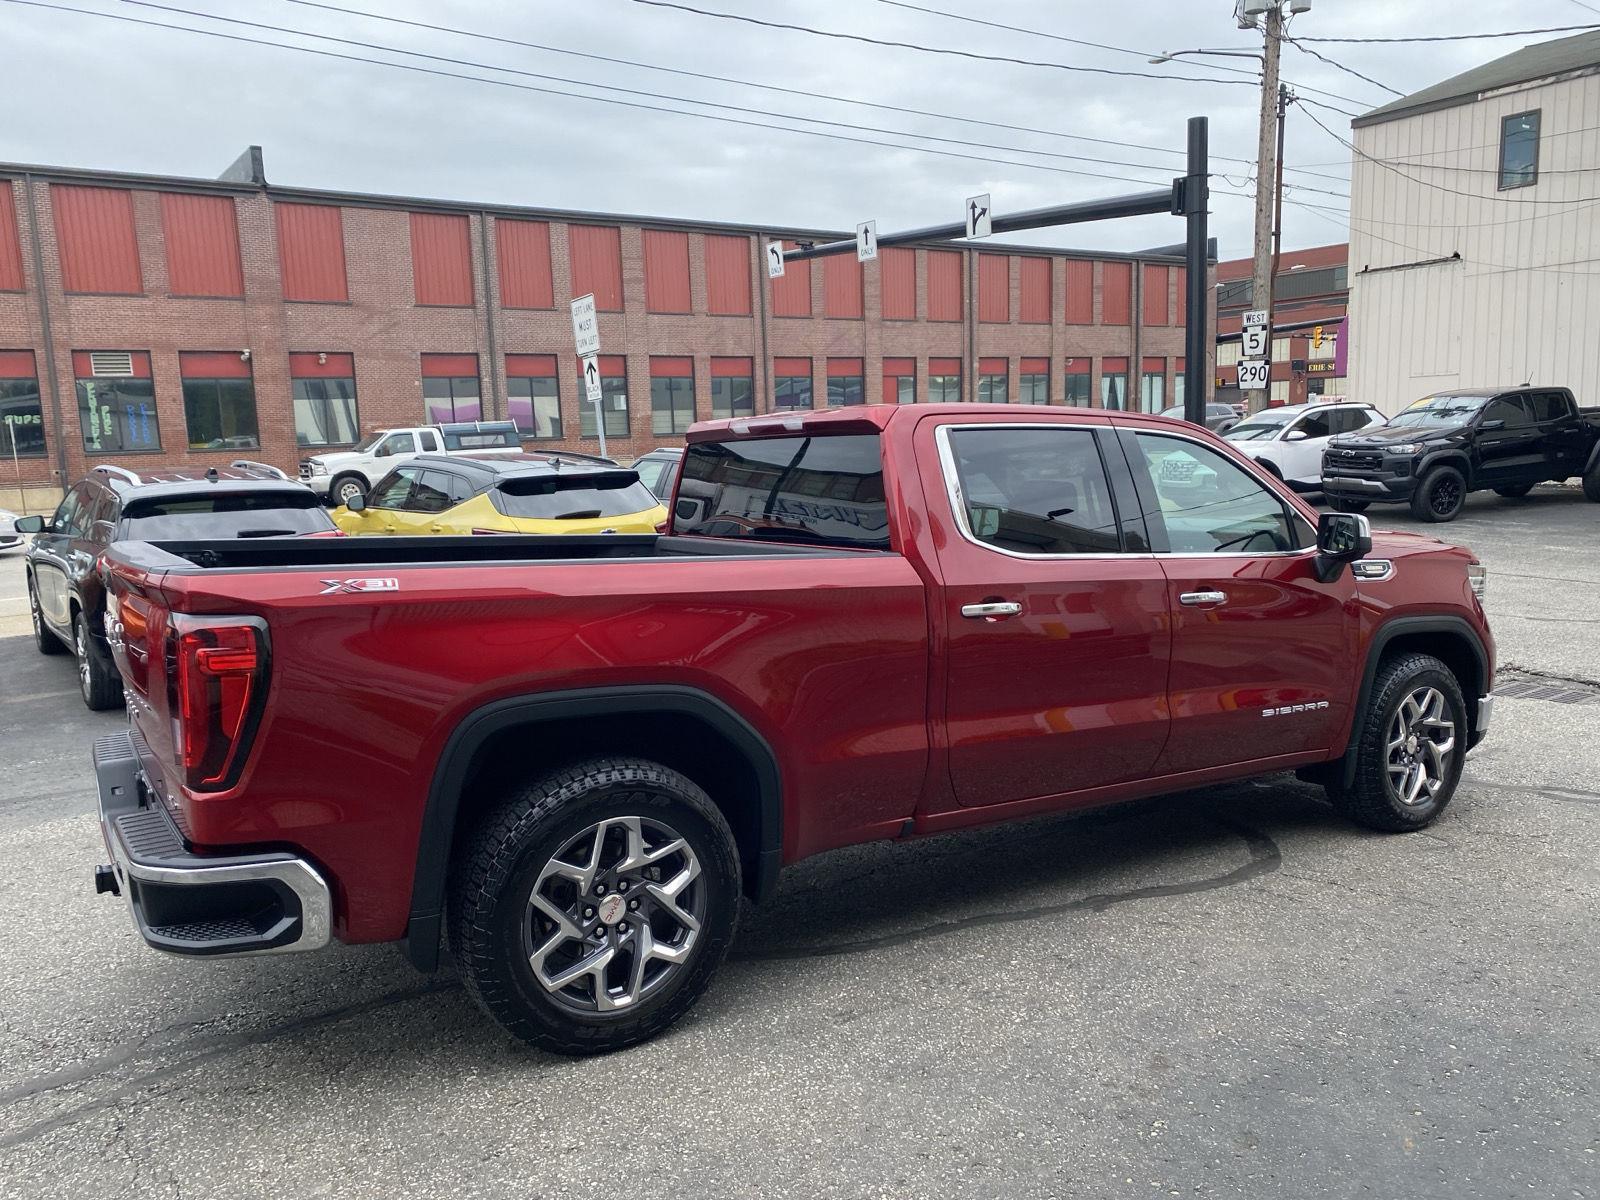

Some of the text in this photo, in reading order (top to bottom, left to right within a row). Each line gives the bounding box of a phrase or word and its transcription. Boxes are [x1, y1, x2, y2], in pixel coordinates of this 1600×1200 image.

[861, 247, 874, 256] ONLY
[770, 266, 782, 275] ONLY
[574, 302, 594, 316] LEFT LANE
[1246, 313, 1265, 324] WEST
[579, 319, 592, 332] MUST
[578, 335, 597, 348] TURN LEFT
[1249, 333, 1260, 350] 5
[1240, 365, 1267, 383] 290
[1308, 363, 1326, 372] ERIE
[319, 578, 400, 595] X31
[1262, 701, 1330, 717] SIERRA
